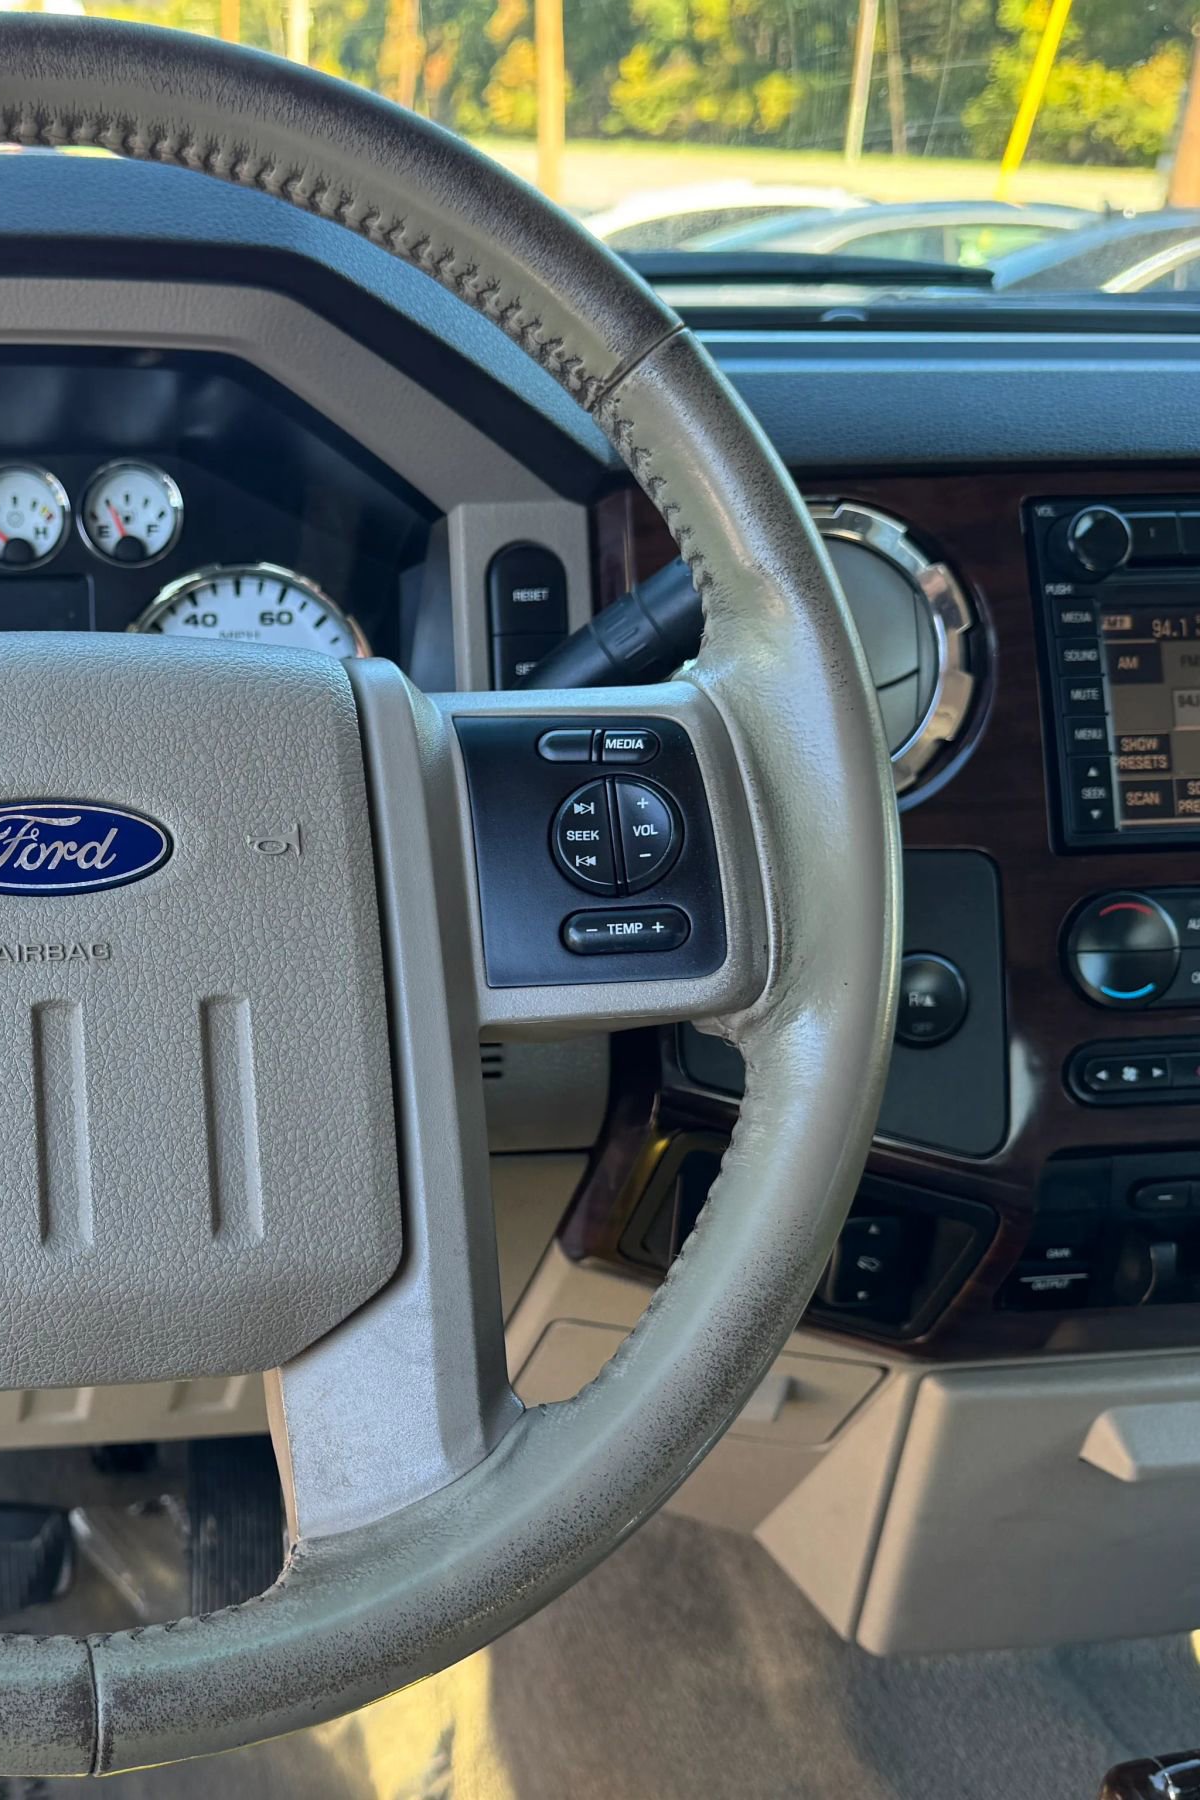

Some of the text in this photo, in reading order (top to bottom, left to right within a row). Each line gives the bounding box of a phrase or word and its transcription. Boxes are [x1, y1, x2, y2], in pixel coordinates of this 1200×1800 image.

[98, 525, 110, 538] E
[146, 524, 158, 537] F
[512, 588, 548, 602] RESET
[1045, 583, 1072, 595] PUSH
[182, 613, 218, 628] 40
[259, 611, 294, 627] 60
[1061, 611, 1091, 623] MEDIA
[1152, 618, 1187, 638] 94.1
[1064, 649, 1097, 662] SOUND
[1118, 656, 1139, 669] AM
[1070, 688, 1100, 700] MUTE
[1074, 728, 1103, 740] MENU
[605, 738, 644, 750] MEDIA
[1120, 737, 1158, 751] SHOW
[1125, 791, 1161, 806] SCAN
[566, 830, 600, 841] SEEK
[632, 825, 659, 837] VOL
[606, 922, 643, 935] TEMP
